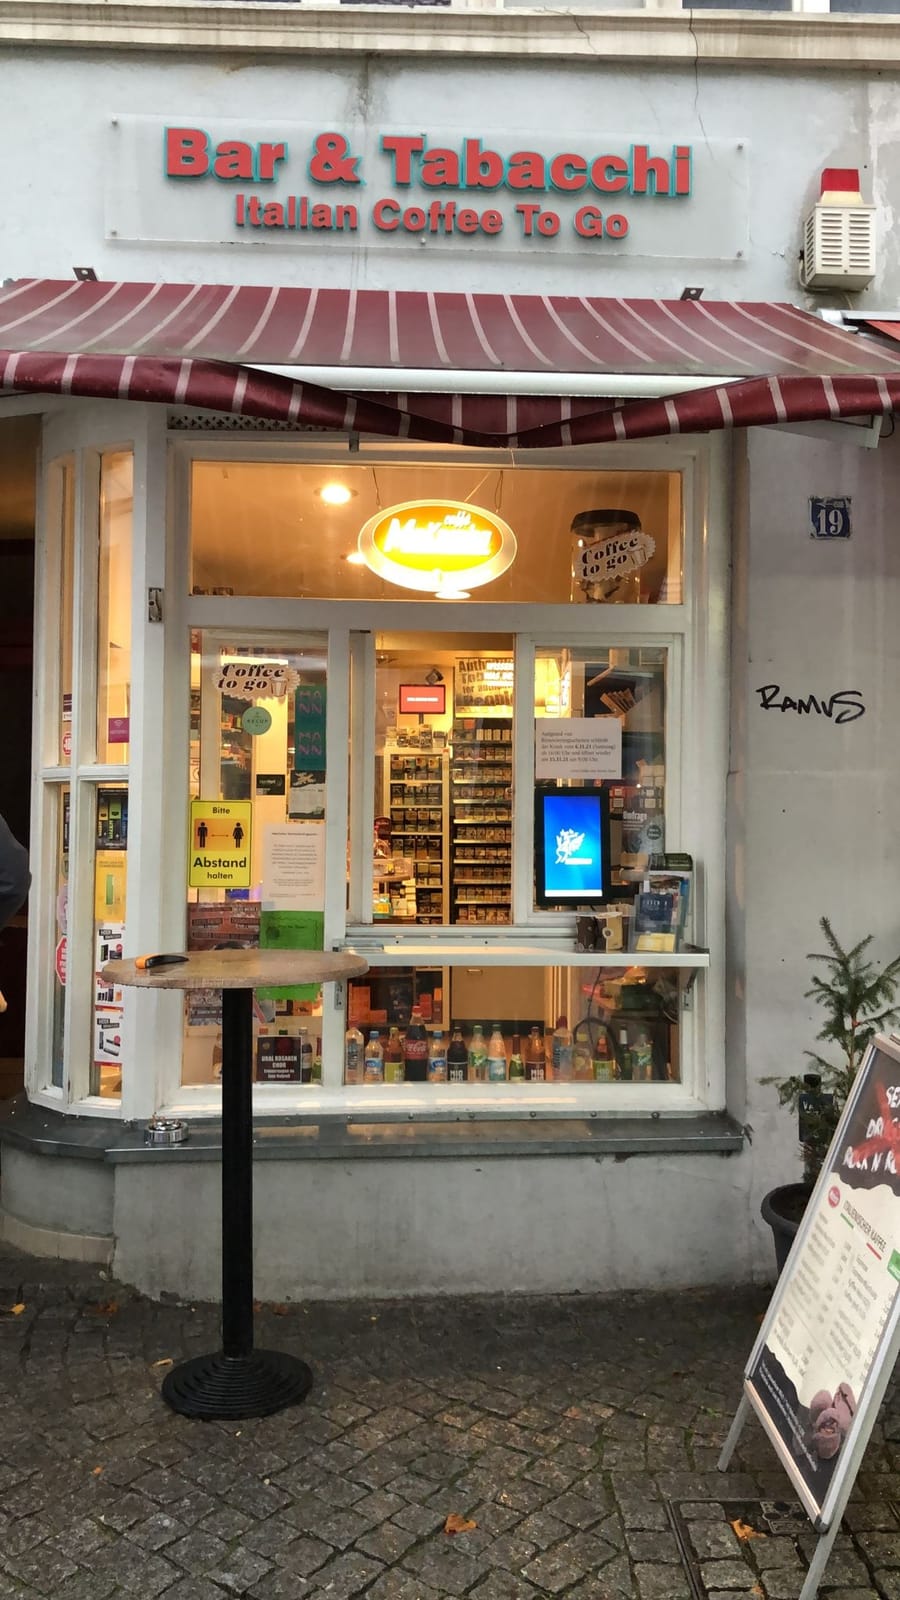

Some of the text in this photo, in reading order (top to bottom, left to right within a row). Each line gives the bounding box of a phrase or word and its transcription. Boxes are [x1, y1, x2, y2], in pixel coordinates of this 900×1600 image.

[164, 126, 693, 197] Bar & Tabacchi
[235, 193, 630, 239] Italian Coffee To Go
[816, 508, 844, 535] 19
[581, 538, 639, 564] Coffee
[582, 555, 628, 577] to go
[222, 664, 285, 678] Coffee
[217, 678, 268, 692] to go
[212, 806, 231, 814] Bitte
[193, 856, 247, 868] Abstand
